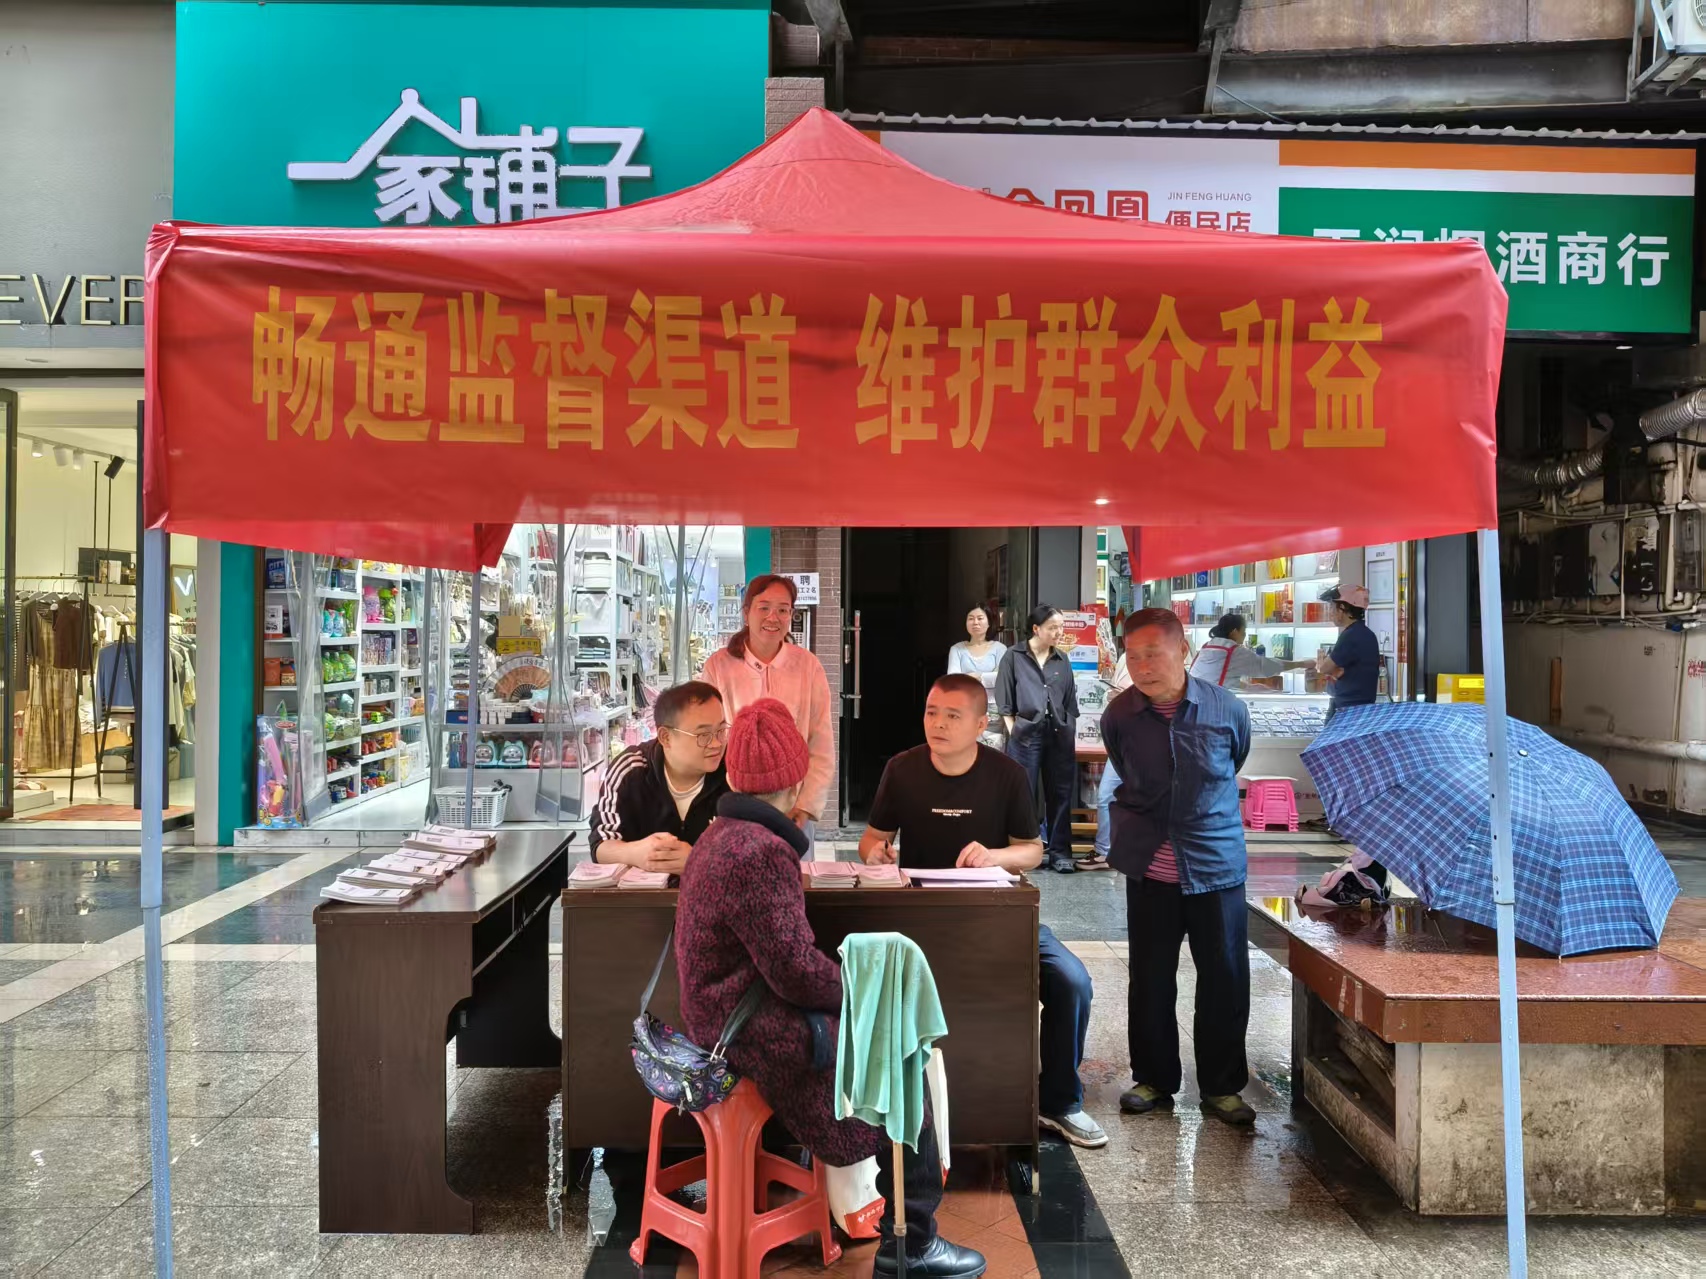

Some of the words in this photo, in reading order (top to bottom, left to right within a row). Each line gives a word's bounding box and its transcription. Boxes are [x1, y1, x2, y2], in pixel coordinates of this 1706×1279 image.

[1168, 192, 1183, 200] JIN
[1185, 192, 1213, 200] FENG
[1216, 193, 1252, 201] HUANG
[252, 285, 800, 450] 畅通监督渠道
[855, 292, 1386, 453] 维护群众利益
